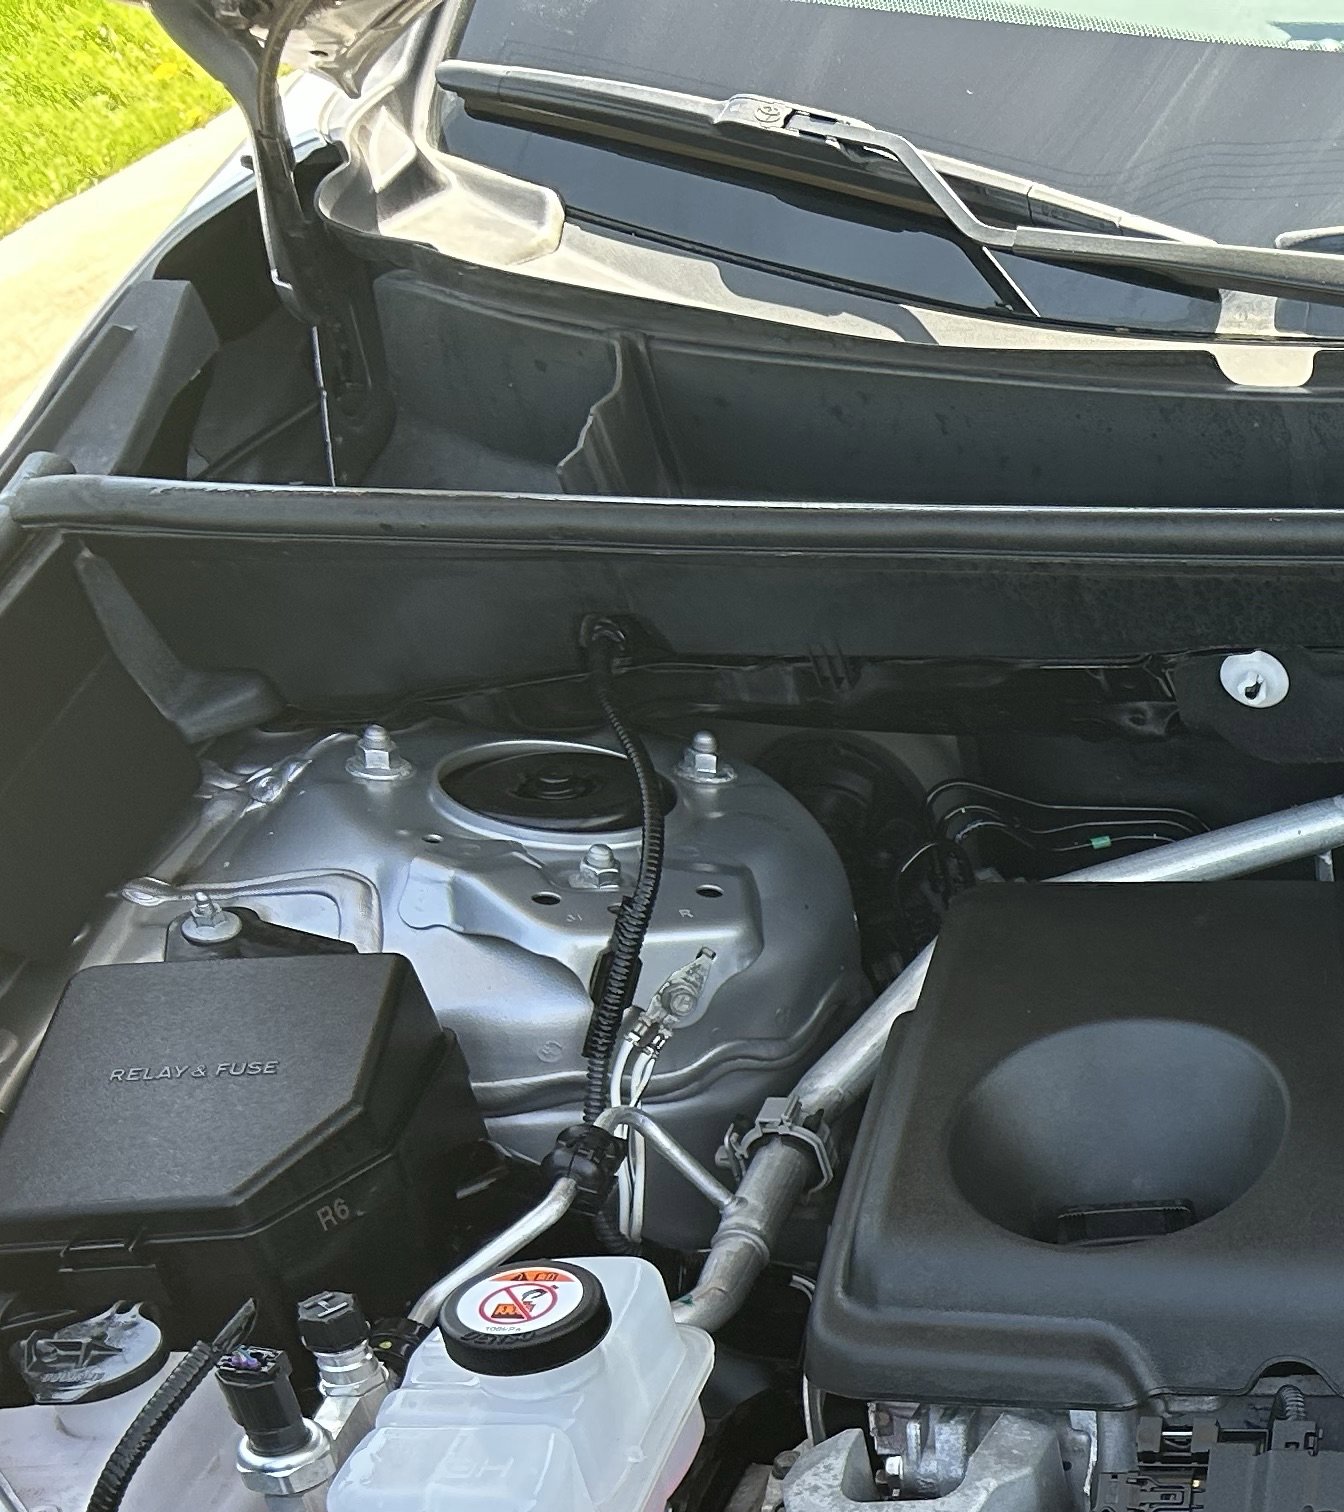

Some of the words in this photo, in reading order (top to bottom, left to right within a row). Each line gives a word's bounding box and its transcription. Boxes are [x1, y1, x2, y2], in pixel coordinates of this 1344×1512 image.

[109, 1065, 189, 1081] RELAY
[190, 1064, 208, 1078] &
[216, 1060, 279, 1077] FUSE
[316, 1197, 350, 1232] R6
